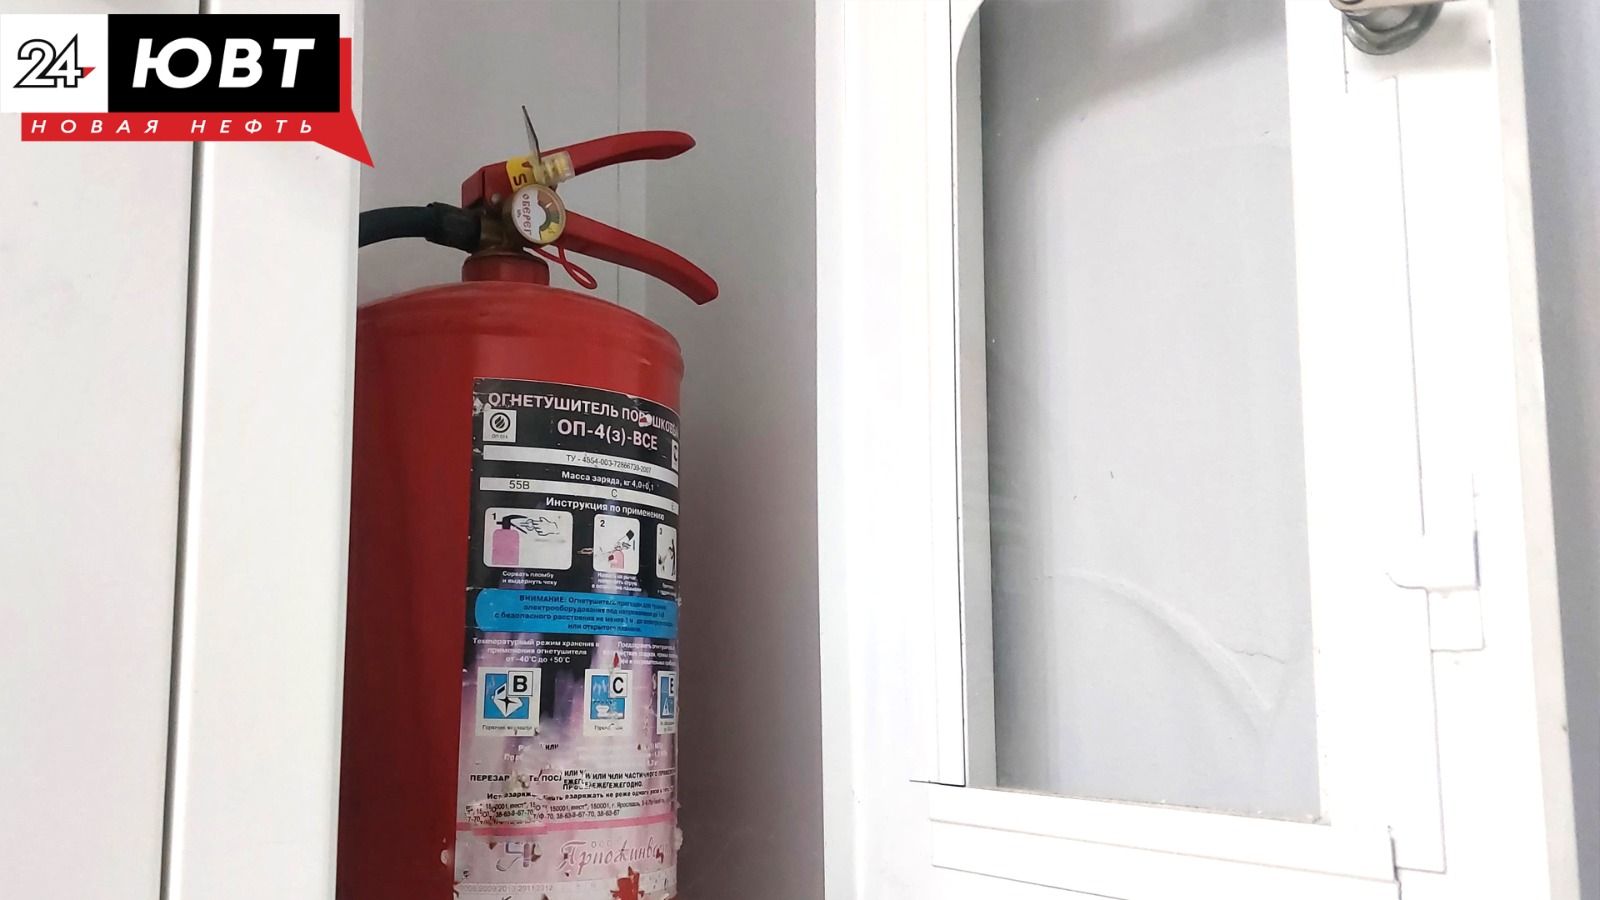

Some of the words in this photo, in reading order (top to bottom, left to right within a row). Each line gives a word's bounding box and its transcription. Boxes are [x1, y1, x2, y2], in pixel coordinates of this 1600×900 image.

[488, 392, 619, 418] ОГНЕТУШИТЕЛЬ
[566, 454, 576, 462] ТУ
[561, 471, 591, 481] Масса
[591, 475, 623, 487] заряда,
[545, 497, 608, 512] Инструкция
[609, 502, 621, 512] по
[622, 505, 666, 521] применению
[491, 512, 497, 521] 1
[599, 519, 606, 528] 2
[535, 639, 561, 647] режим
[536, 648, 588, 656] огнетушителя
[512, 675, 528, 693] B
[612, 676, 624, 694] C
